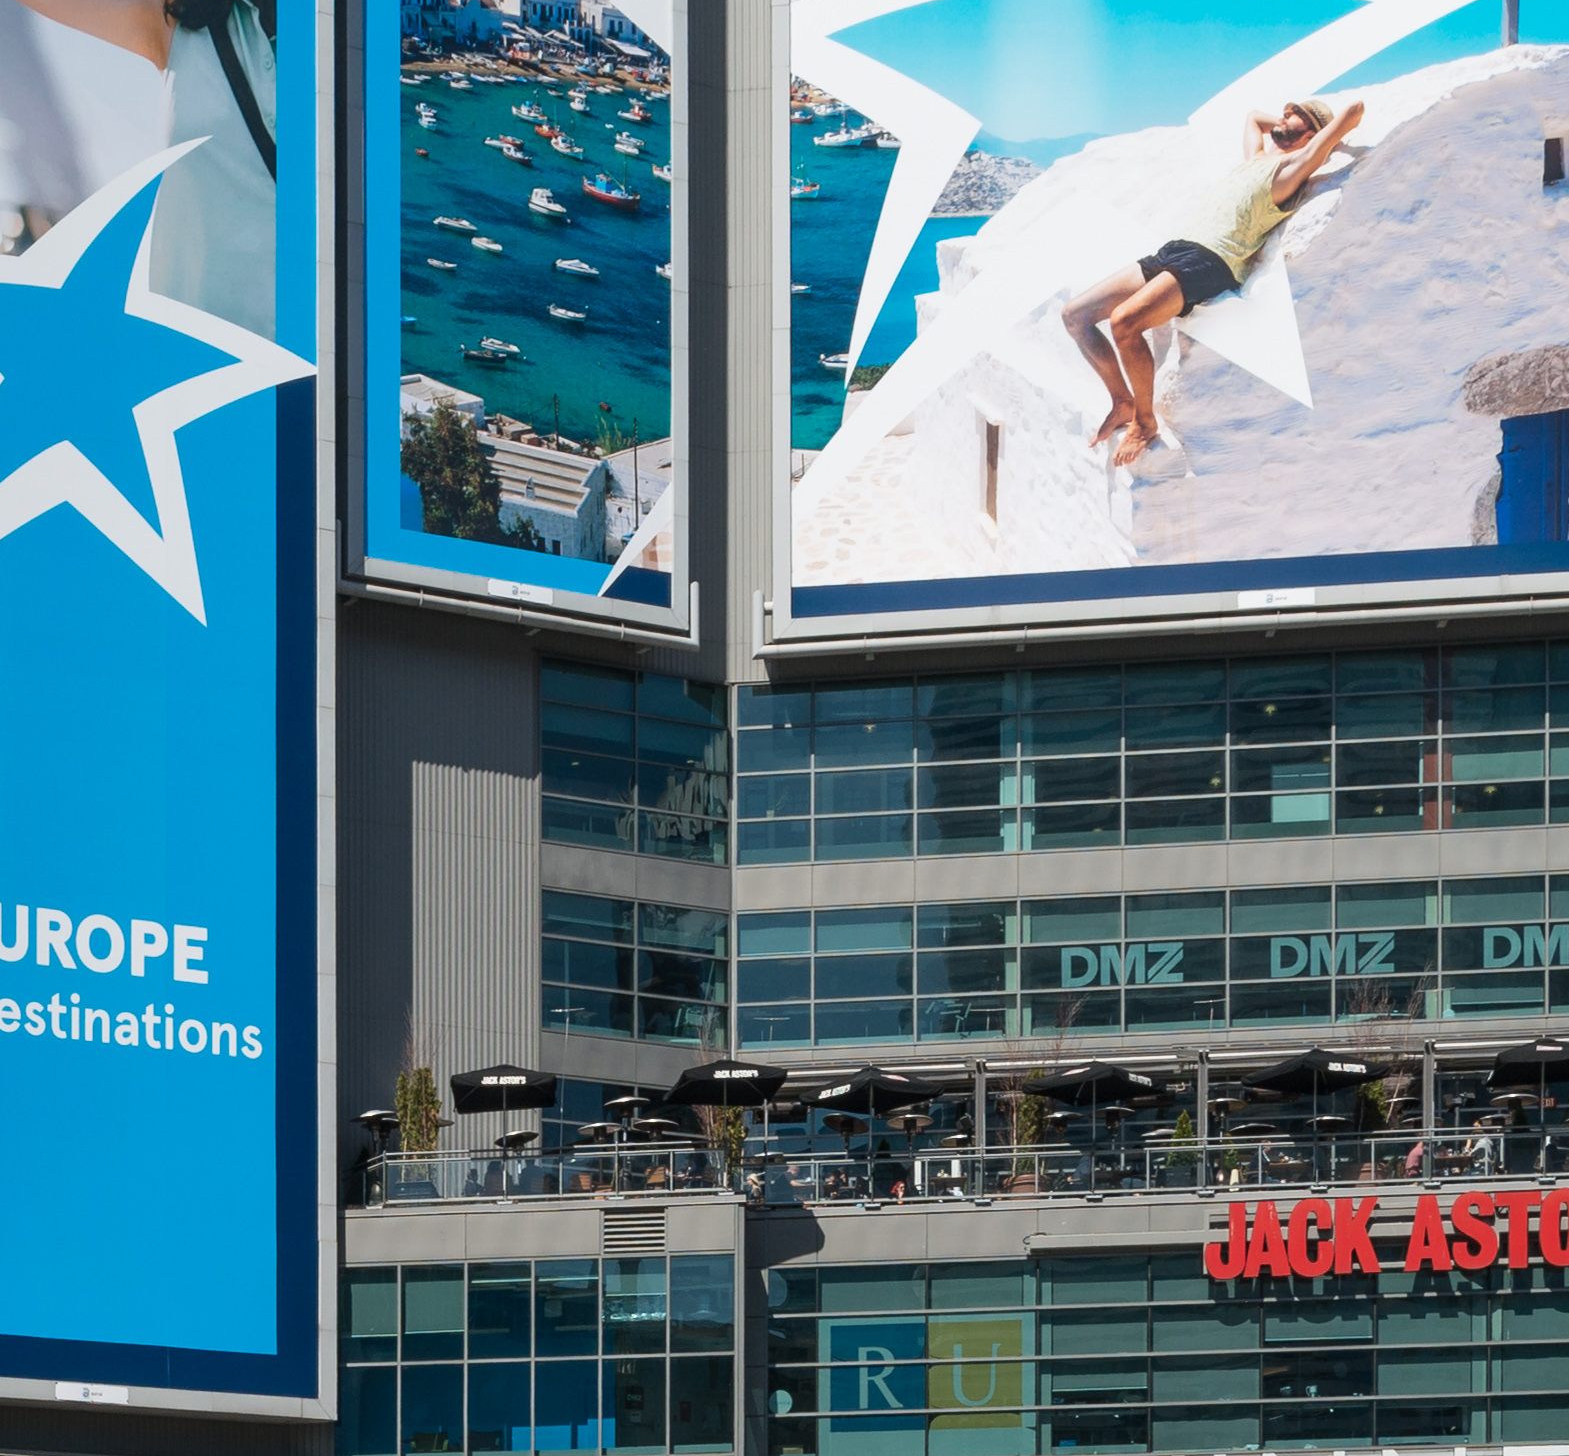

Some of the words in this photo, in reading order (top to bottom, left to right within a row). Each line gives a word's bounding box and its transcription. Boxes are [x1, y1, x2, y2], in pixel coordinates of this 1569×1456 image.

[1061, 941, 1185, 988] DMZ
[1270, 931, 1396, 978] DMZ
[1204, 1196, 1380, 1280] JACK
